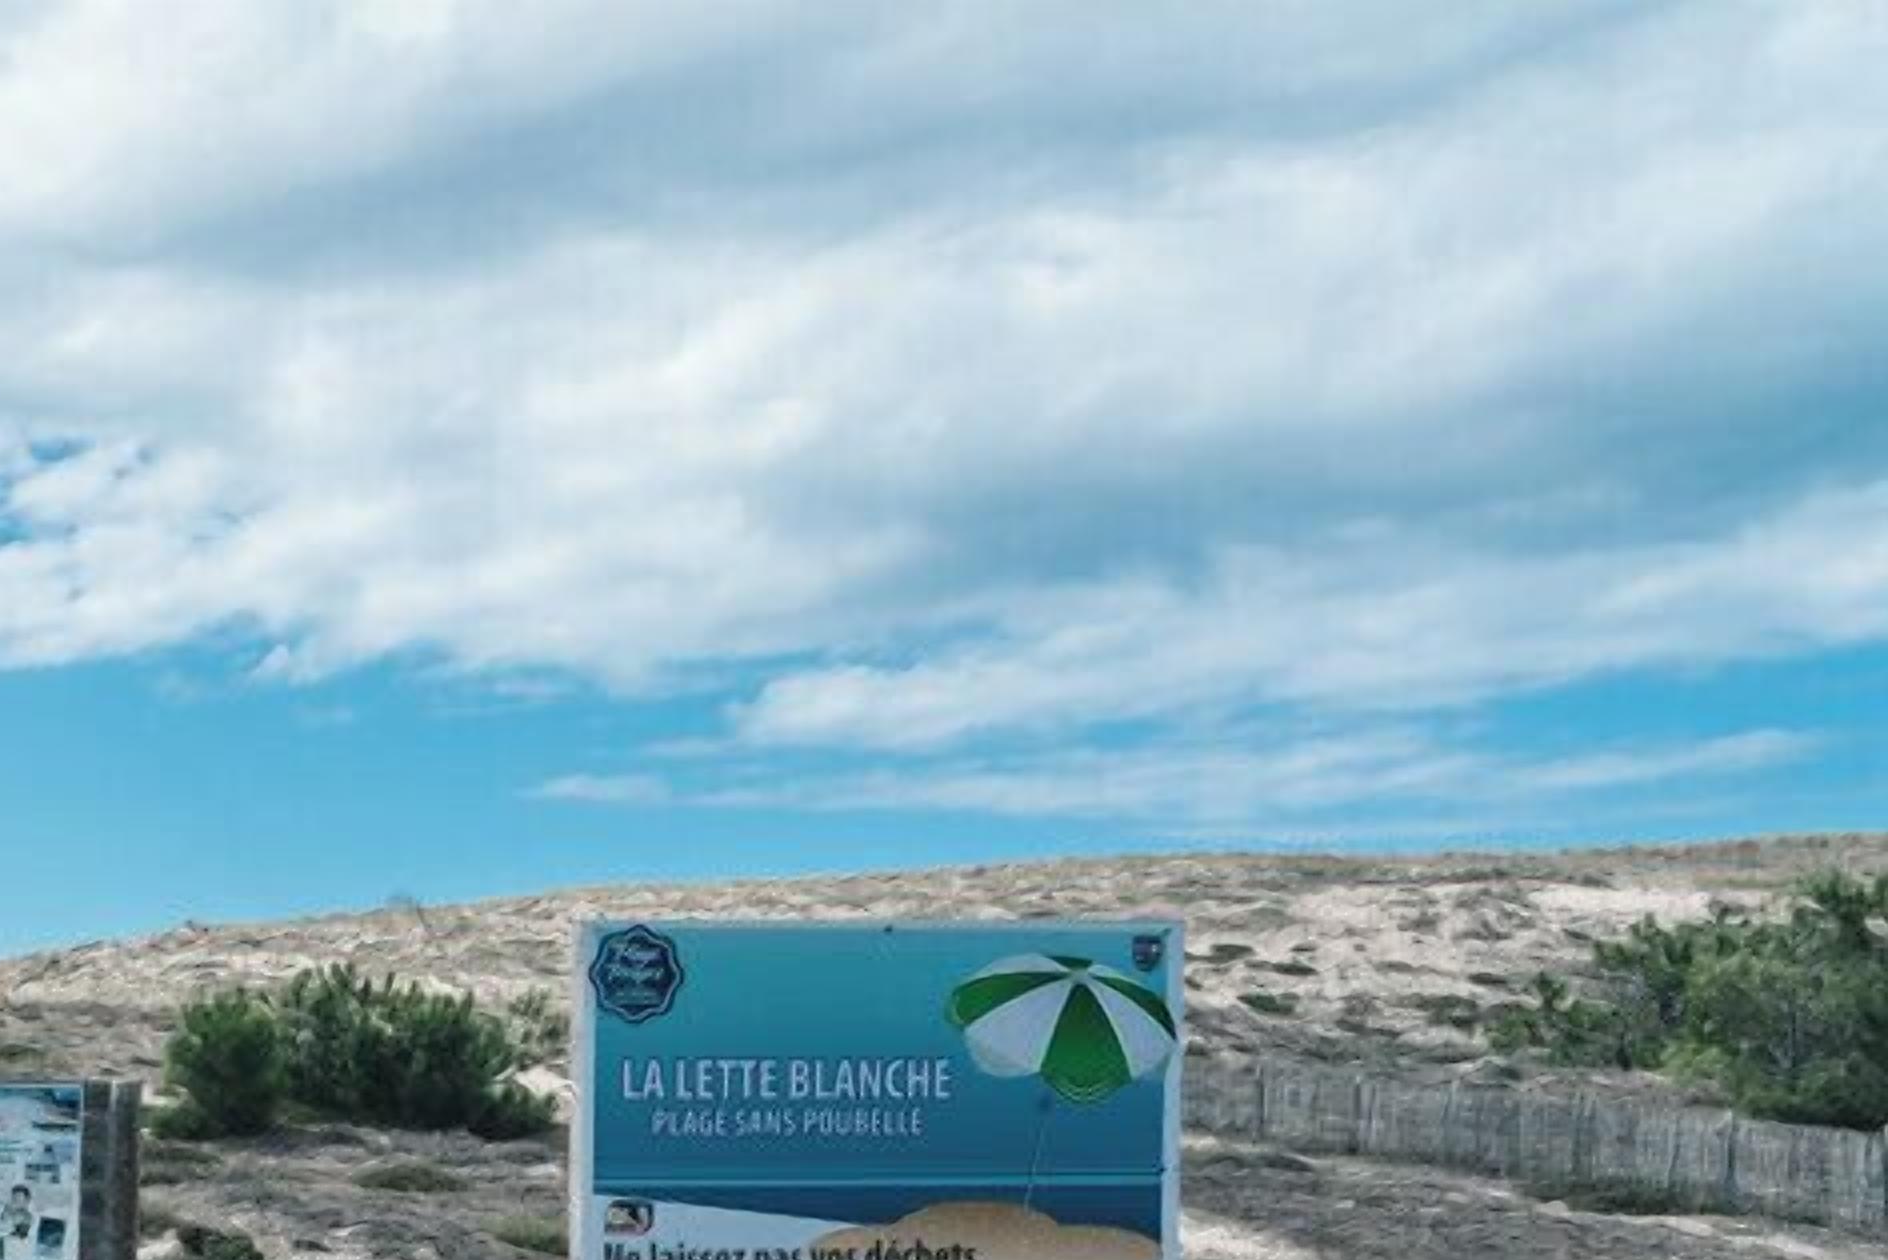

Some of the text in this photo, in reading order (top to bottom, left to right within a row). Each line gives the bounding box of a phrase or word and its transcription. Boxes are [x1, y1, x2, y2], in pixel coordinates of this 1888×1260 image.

[622, 1057, 952, 1101] LA LETTE BLANCHE
[651, 1106, 923, 1137] PLAGE SANS POUBELLE
